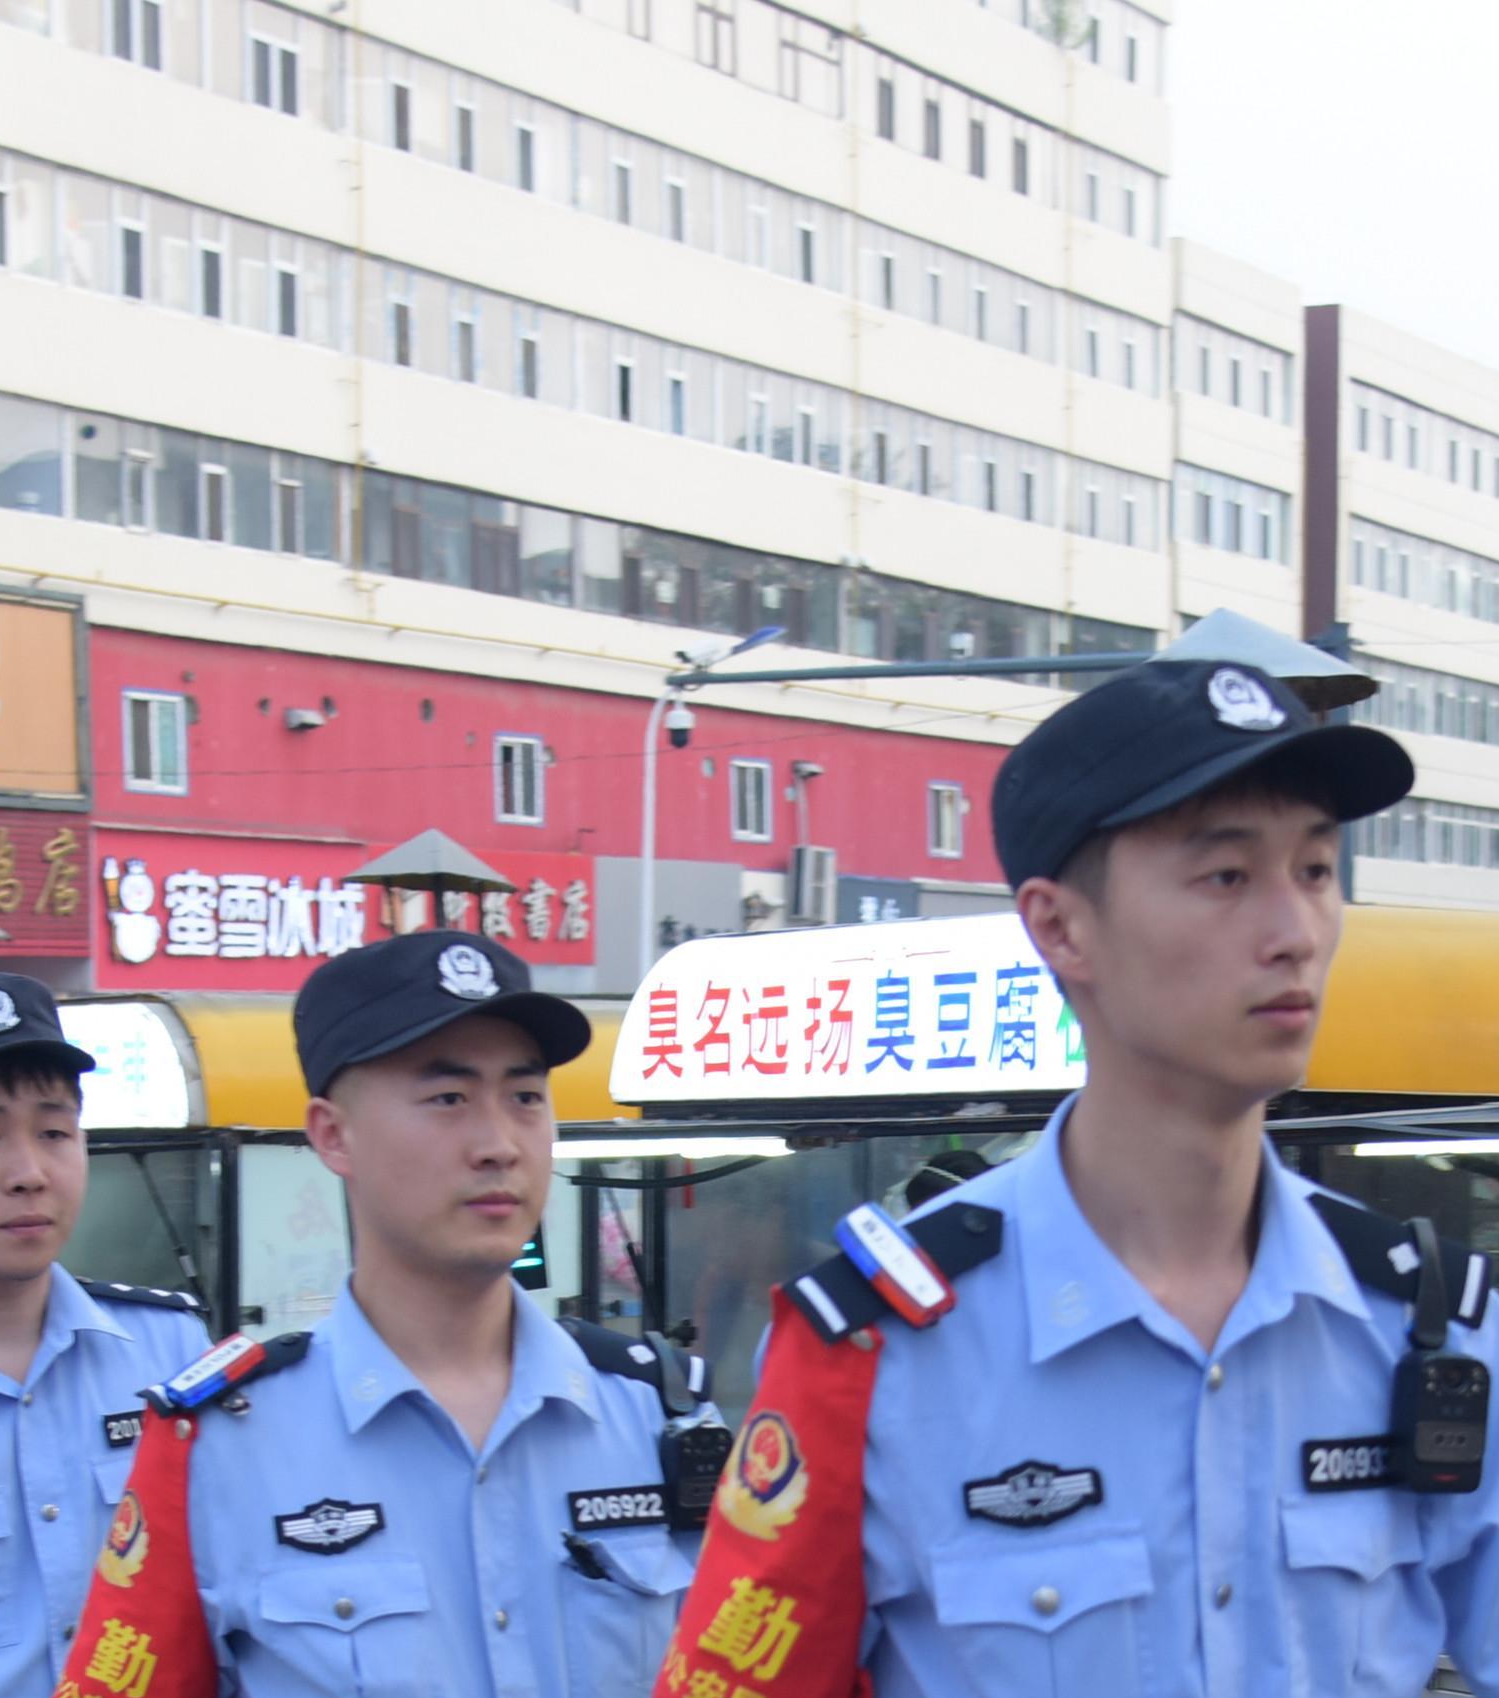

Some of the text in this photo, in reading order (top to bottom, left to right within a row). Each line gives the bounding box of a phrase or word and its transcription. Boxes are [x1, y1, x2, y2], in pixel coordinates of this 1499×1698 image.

[165, 868, 365, 958] 蜜雪冰城
[575, 1493, 664, 1522] 206922
[85, 1617, 158, 1698] 勤
[697, 1575, 801, 1681] 勤
